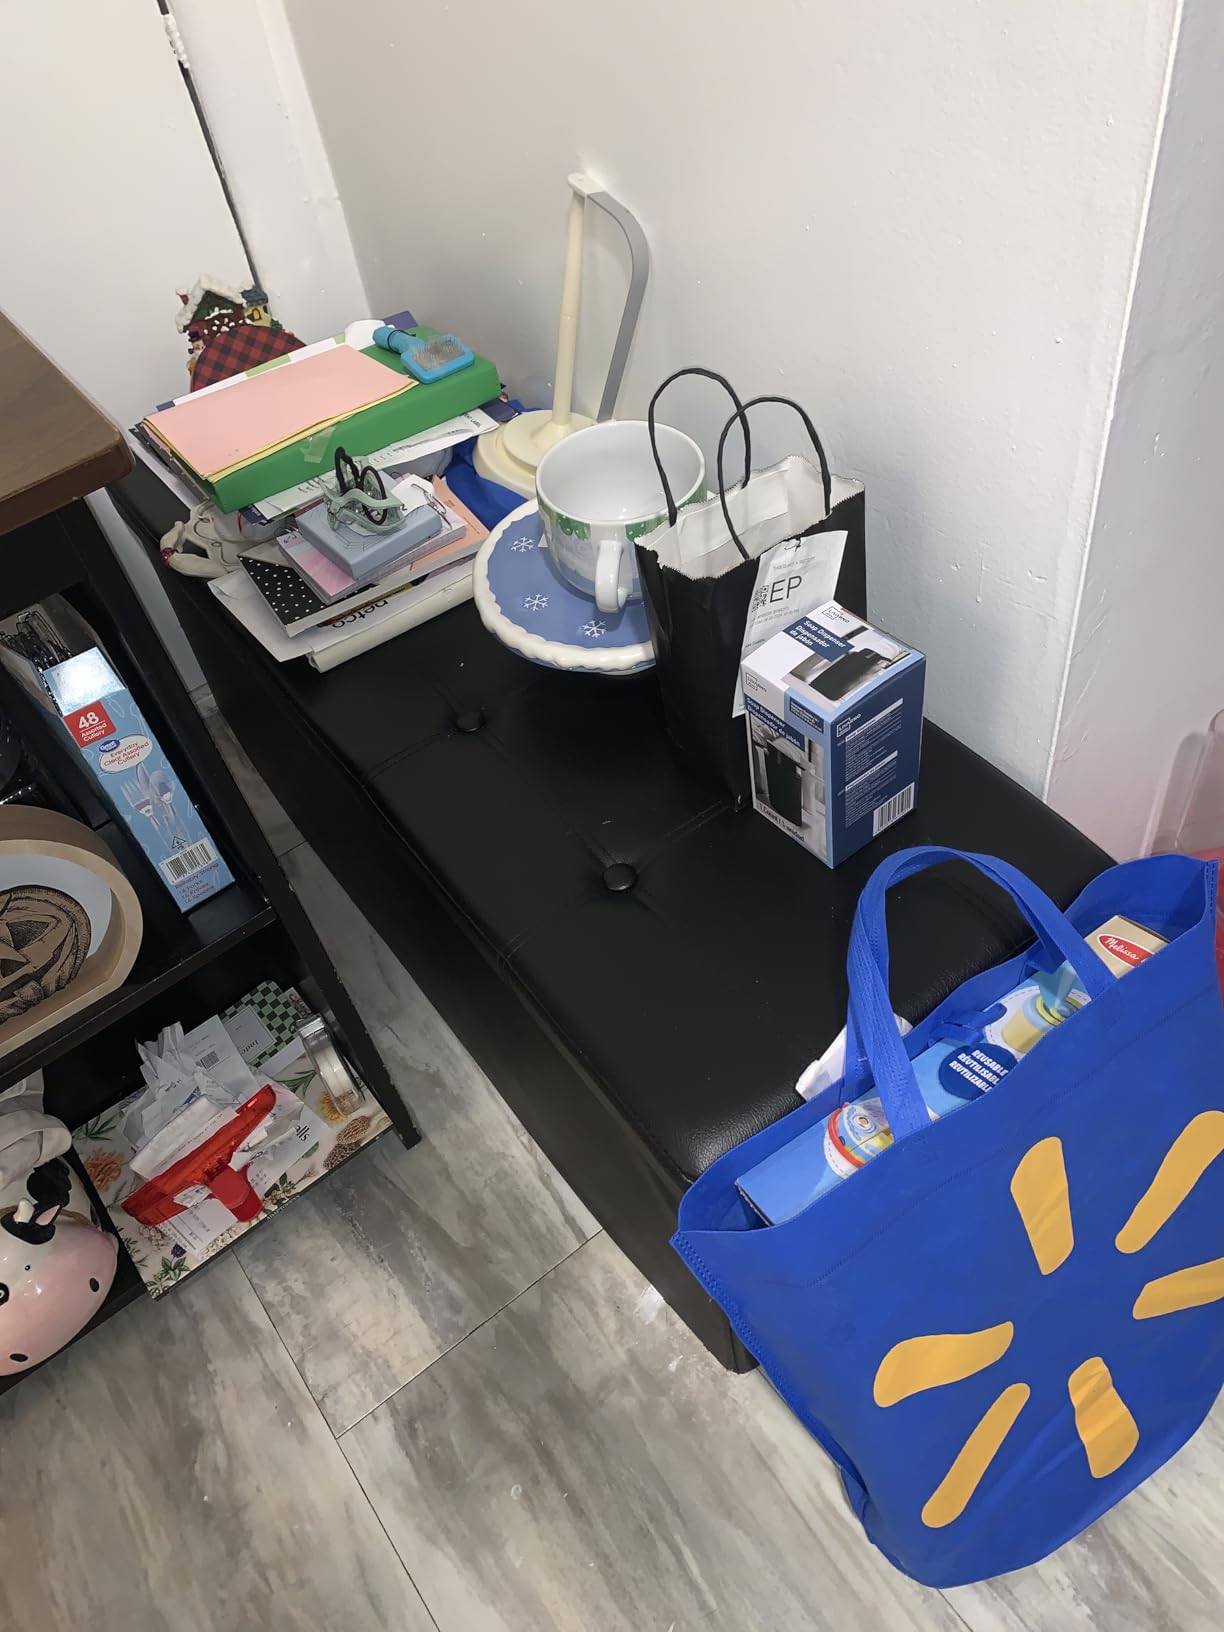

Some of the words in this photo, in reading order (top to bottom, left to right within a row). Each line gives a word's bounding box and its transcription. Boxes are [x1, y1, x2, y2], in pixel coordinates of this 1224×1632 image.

[769, 575, 803, 603] EP
[795, 625, 830, 648] Dispensador
[796, 634, 814, 646] jabón
[803, 620, 819, 632] Soap
[817, 628, 847, 648] Dispenser
[78, 711, 99, 729] 48
[81, 722, 108, 738] Assorted
[83, 729, 105, 742] Cutlery
[103, 753, 122, 767] Clear
[122, 741, 150, 758] Assorted
[110, 741, 139, 758] Everyday
[117, 751, 140, 765] Cutlery
[1105, 937, 1139, 960] Melissa
[957, 1053, 1000, 1085] RÉUTILISABL
[971, 1049, 1009, 1077] REUSABLE
